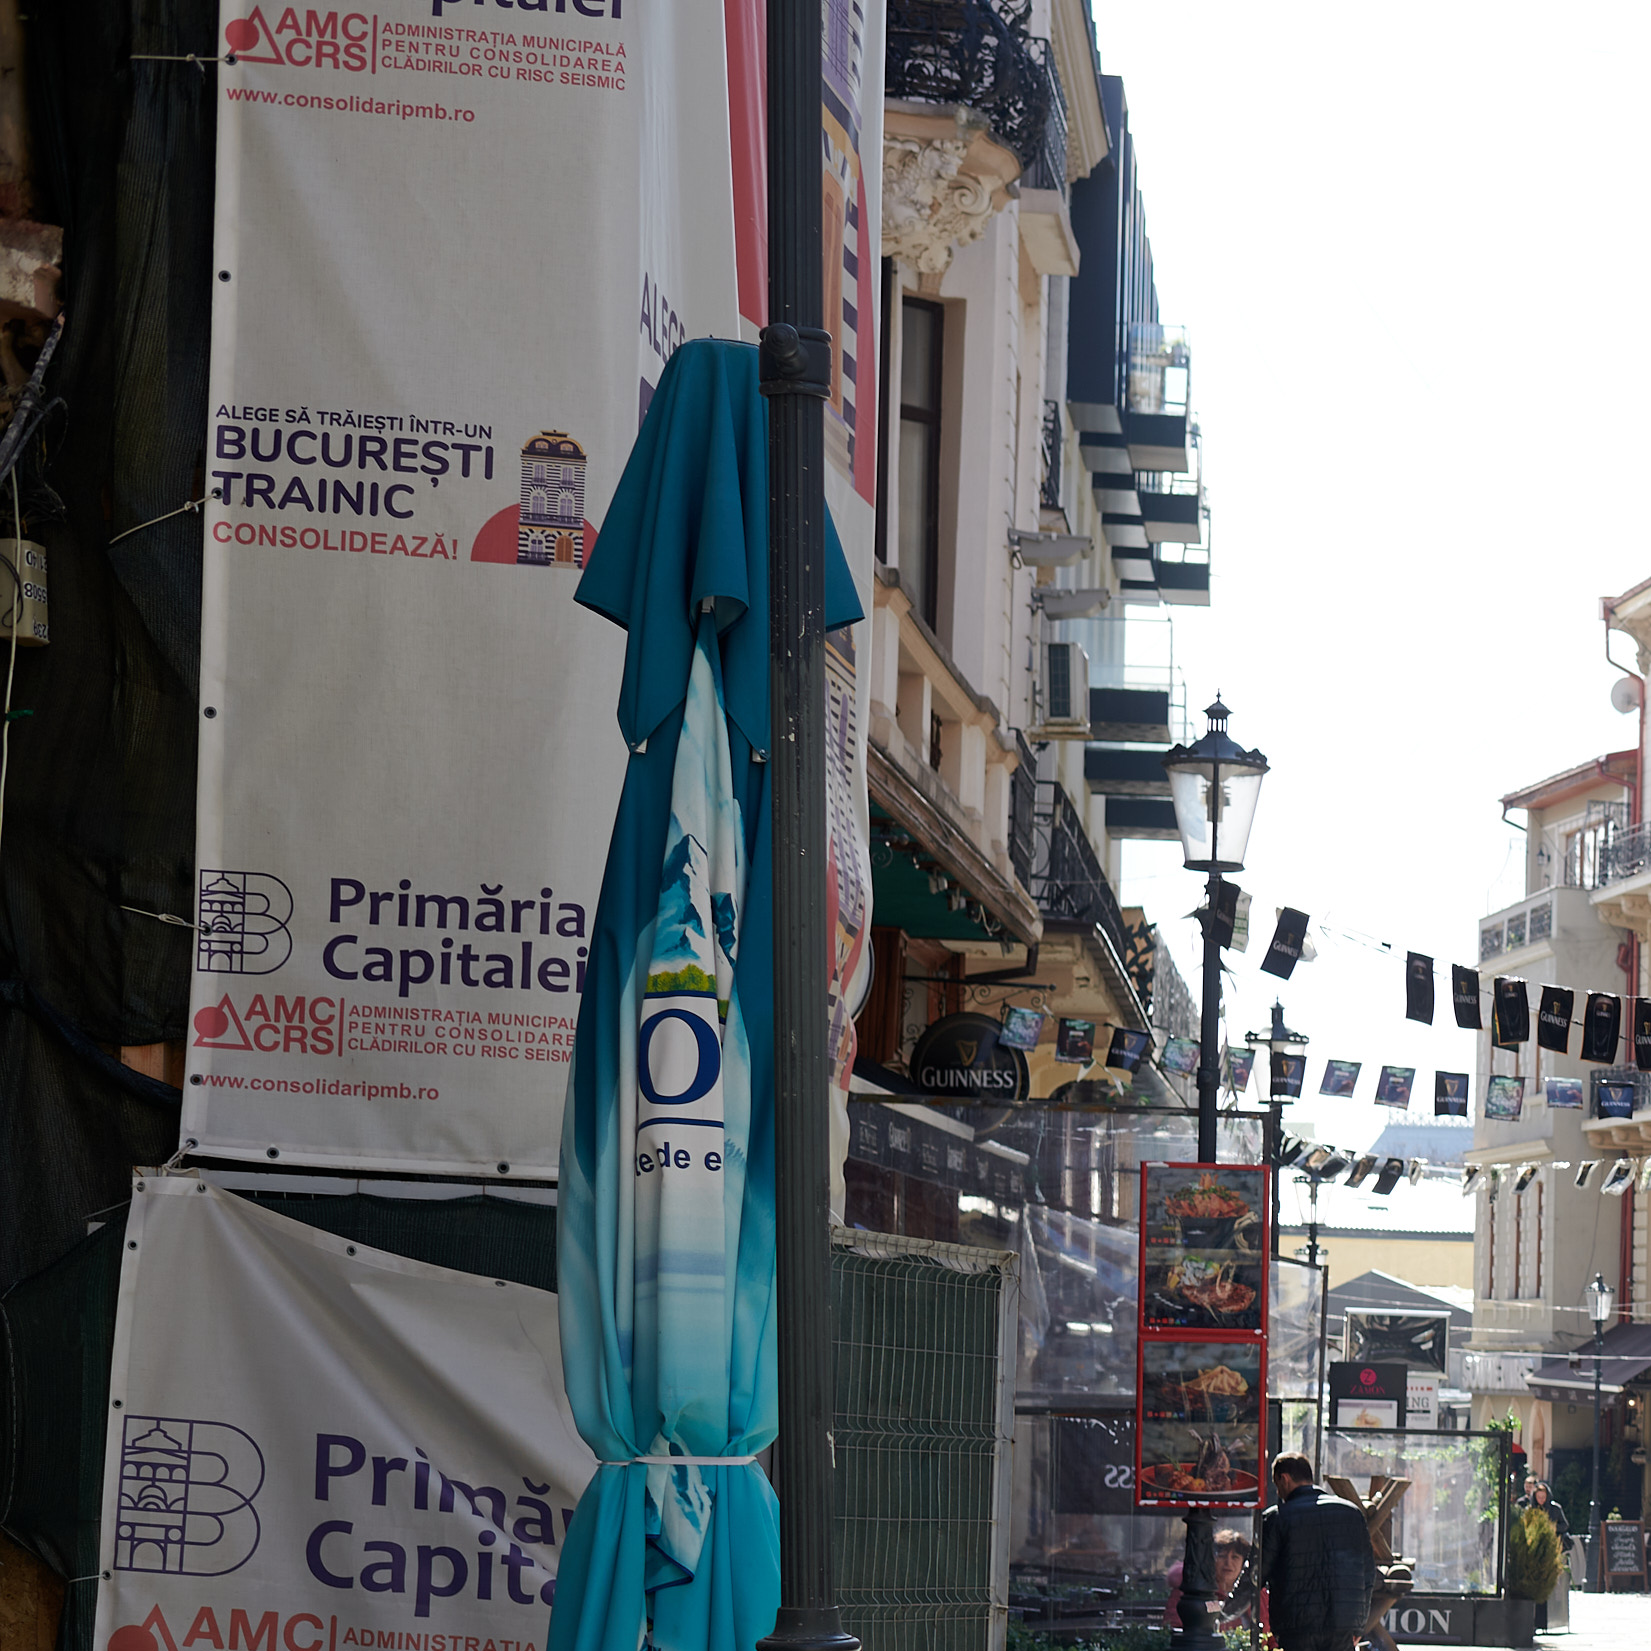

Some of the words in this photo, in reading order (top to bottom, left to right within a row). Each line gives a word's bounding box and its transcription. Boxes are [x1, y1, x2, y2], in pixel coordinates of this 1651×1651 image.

[276, 7, 368, 43] AMC
[382, 22, 517, 48] ADMINISTRAȚIA
[522, 32, 627, 58] MUNICIPALĂ
[284, 38, 368, 72] CRS
[381, 38, 460, 58] PENTRU
[469, 47, 626, 75] CONSOLIDAREA
[381, 53, 483, 77] CLĂDIRILOR
[487, 65, 511, 80] CU
[516, 67, 555, 84] RISC
[559, 71, 626, 91] SEISMIC
[226, 87, 476, 123] www.consolidaripmb.ro
[216, 404, 280, 423] ALEGE
[284, 406, 311, 425] SĂ
[316, 409, 404, 434] TRĂIEȘTI
[409, 414, 492, 440] ÎNTR-UN
[216, 425, 494, 488] BUCUREȘTI
[212, 470, 415, 519] TRAINIC
[212, 521, 458, 560] CONSOLIDEAZĂ!
[329, 877, 587, 938] Primăria
[322, 935, 589, 998] Capitalei
[244, 993, 336, 1026] AMC
[348, 1005, 482, 1029] ADMINISTRAȚIA
[487, 1012, 577, 1031] MUNICIPAL
[1540, 1010, 1568, 1028] GUINNESS
[253, 1022, 335, 1055] CRS
[348, 1021, 426, 1038] PENTRU
[435, 1025, 575, 1047] CONSOLIDARE
[348, 1035, 448, 1056] CLĂDIRILOR
[453, 1042, 476, 1058] CU
[480, 1044, 519, 1060] RISC
[524, 1047, 573, 1063] SEISM
[921, 1066, 1015, 1089] GUINNESS
[1350, 1385, 1386, 1396] ZAMON
[314, 1432, 574, 1546] Primă
[305, 1519, 557, 1618] Capit
[1380, 1607, 1452, 1635] MON
